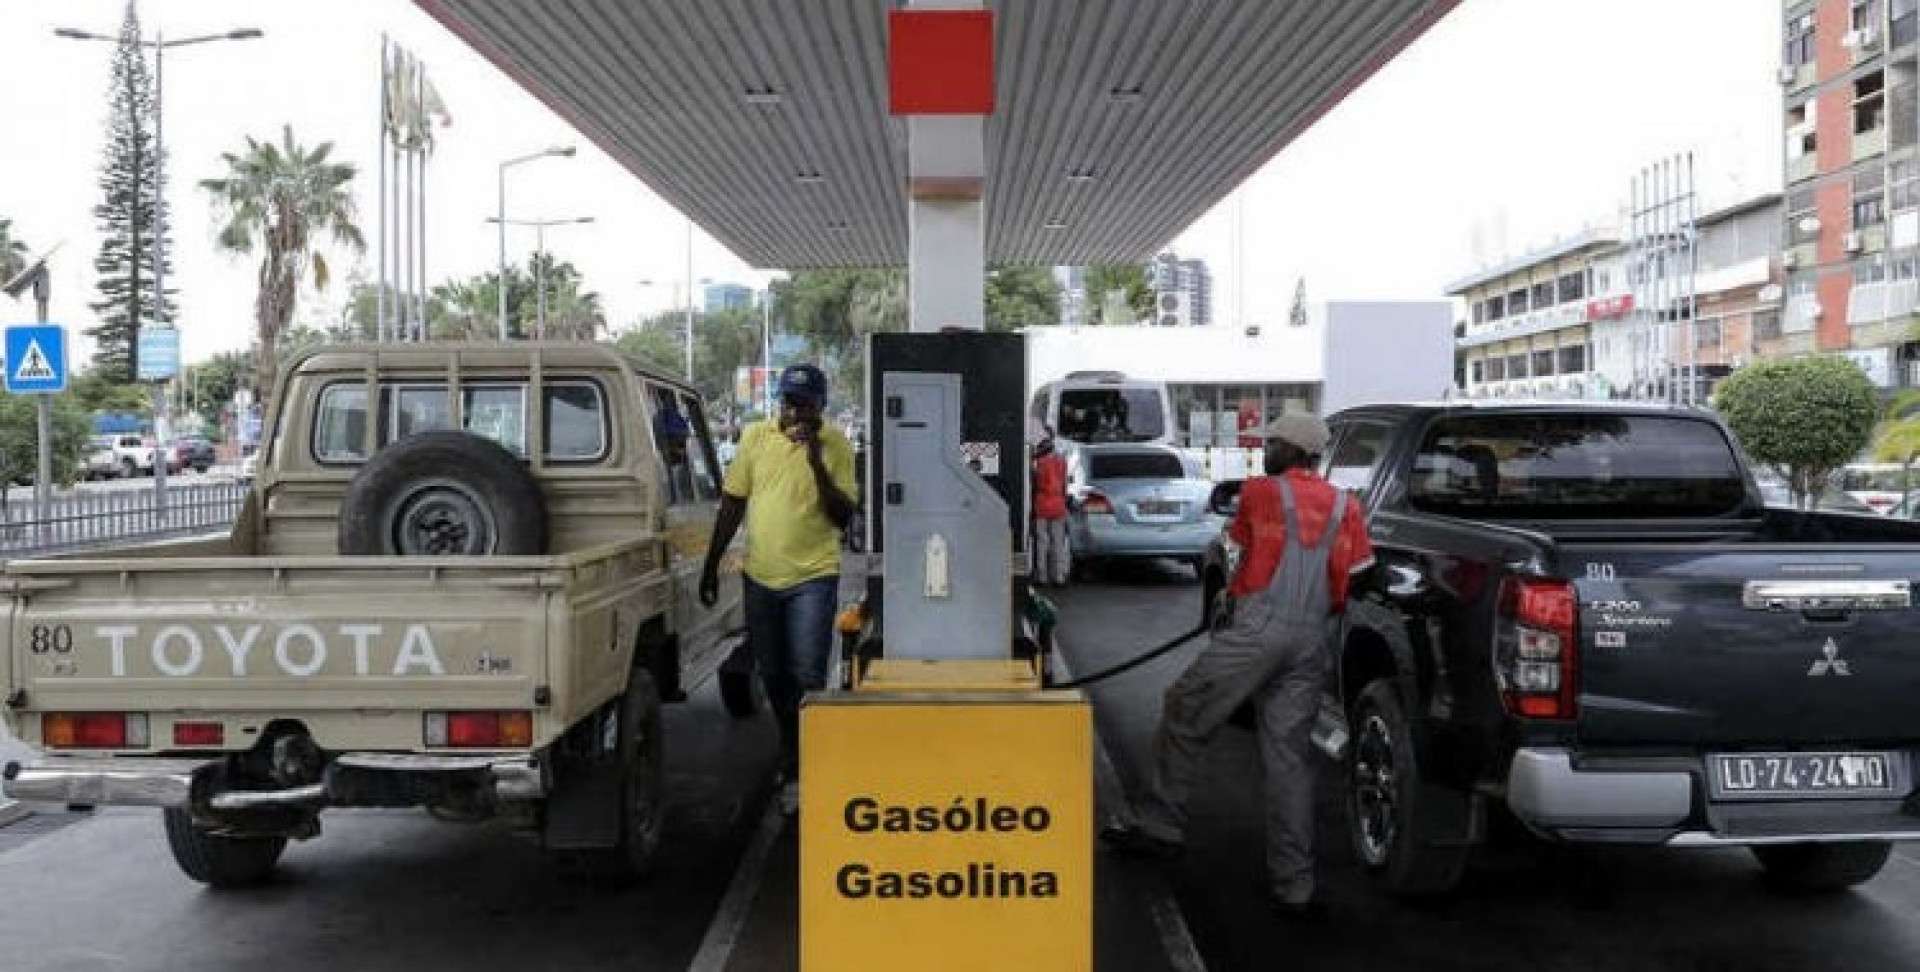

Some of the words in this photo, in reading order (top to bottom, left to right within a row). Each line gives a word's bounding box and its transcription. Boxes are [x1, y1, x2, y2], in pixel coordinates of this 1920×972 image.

[32, 624, 73, 654] 80
[95, 624, 443, 676] TOYOTA
[844, 797, 1050, 832] Gasóleo
[836, 863, 1058, 898] Gasolina
